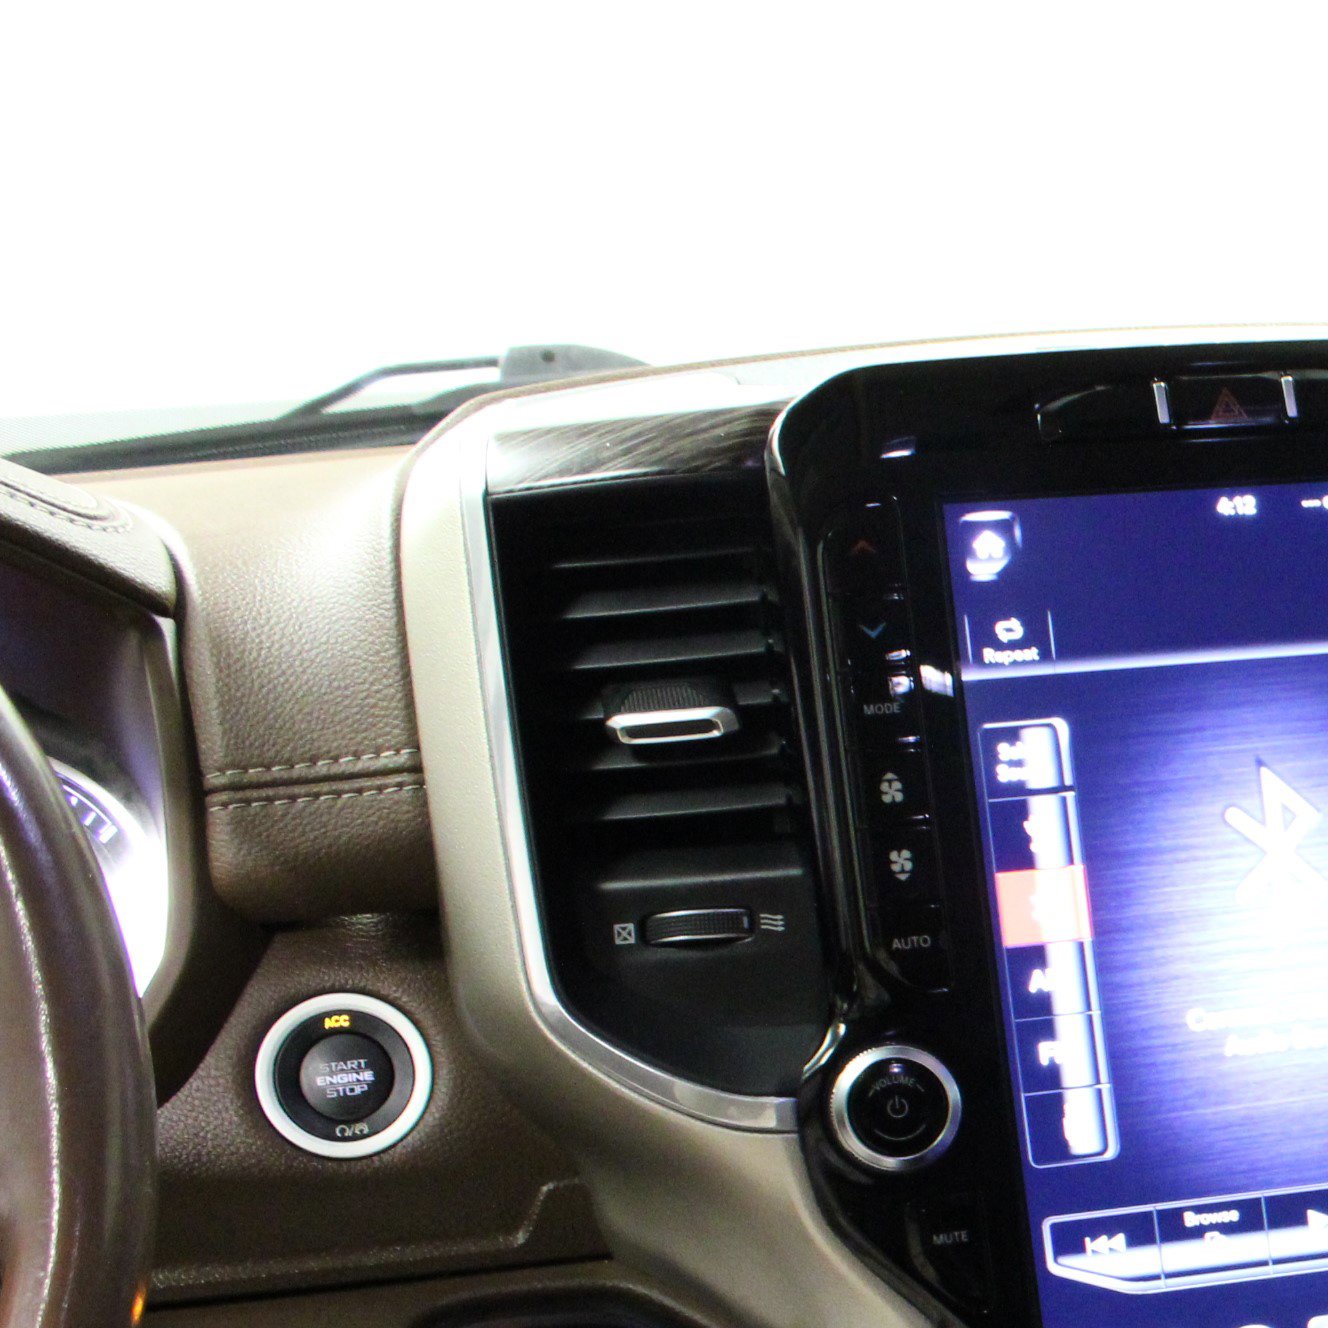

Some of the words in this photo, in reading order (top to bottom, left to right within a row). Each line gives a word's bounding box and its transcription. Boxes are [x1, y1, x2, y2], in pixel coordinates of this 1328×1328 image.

[982, 646, 1040, 666] Repeat
[862, 701, 902, 716] MODE
[891, 935, 932, 950] AUTO
[323, 1014, 351, 1030] ACC
[319, 1058, 368, 1072] START
[315, 1070, 376, 1087] ENGINE
[874, 1075, 917, 1092] VOLUME
[325, 1084, 369, 1099] STOP
[1184, 1209, 1240, 1228] Browse
[932, 1230, 970, 1246] MUTE
